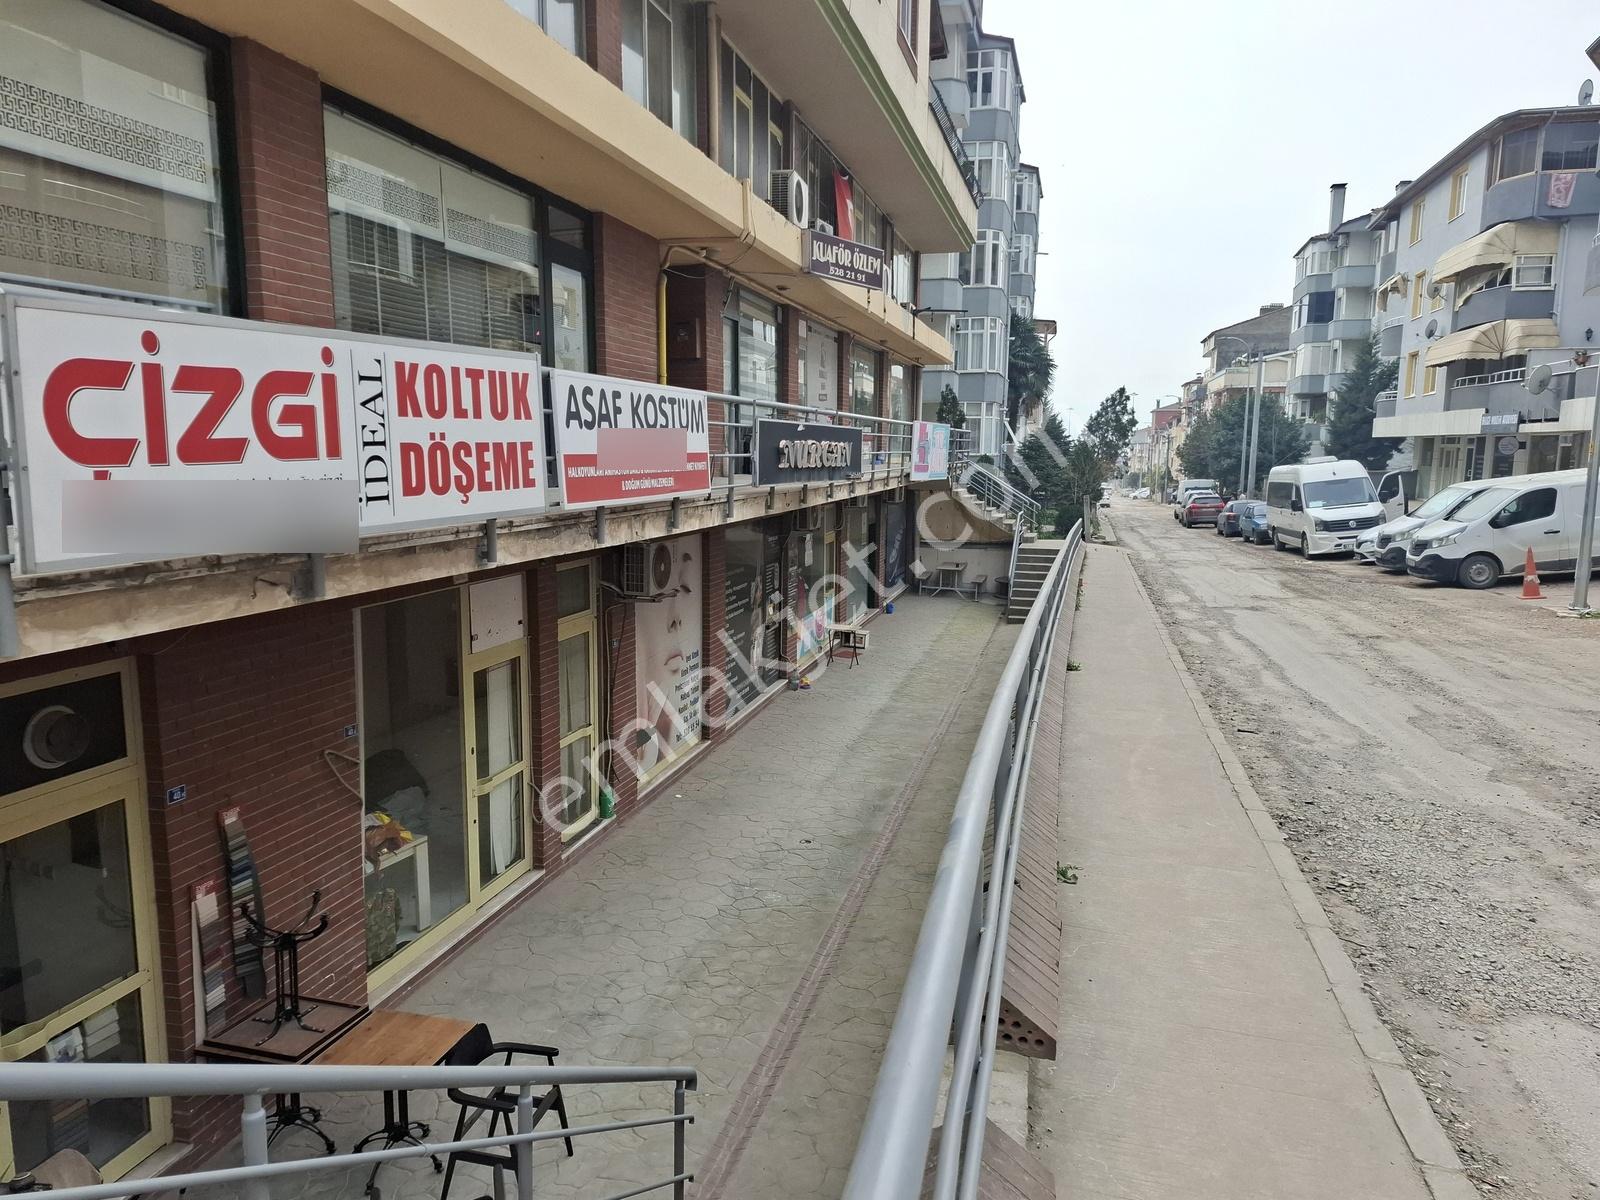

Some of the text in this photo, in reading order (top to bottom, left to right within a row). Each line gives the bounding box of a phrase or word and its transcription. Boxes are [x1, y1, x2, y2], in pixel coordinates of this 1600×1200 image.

[812, 240, 881, 275] KUAFÖR ÖZLEM
[829, 266, 866, 282] 528 21 91
[42, 329, 342, 480] ÇİZGİ
[395, 360, 532, 421] KOLTUK
[565, 384, 705, 434] ASAF KOSTÜM
[358, 357, 390, 508] İDEAL
[400, 432, 536, 504] DÖŞEME
